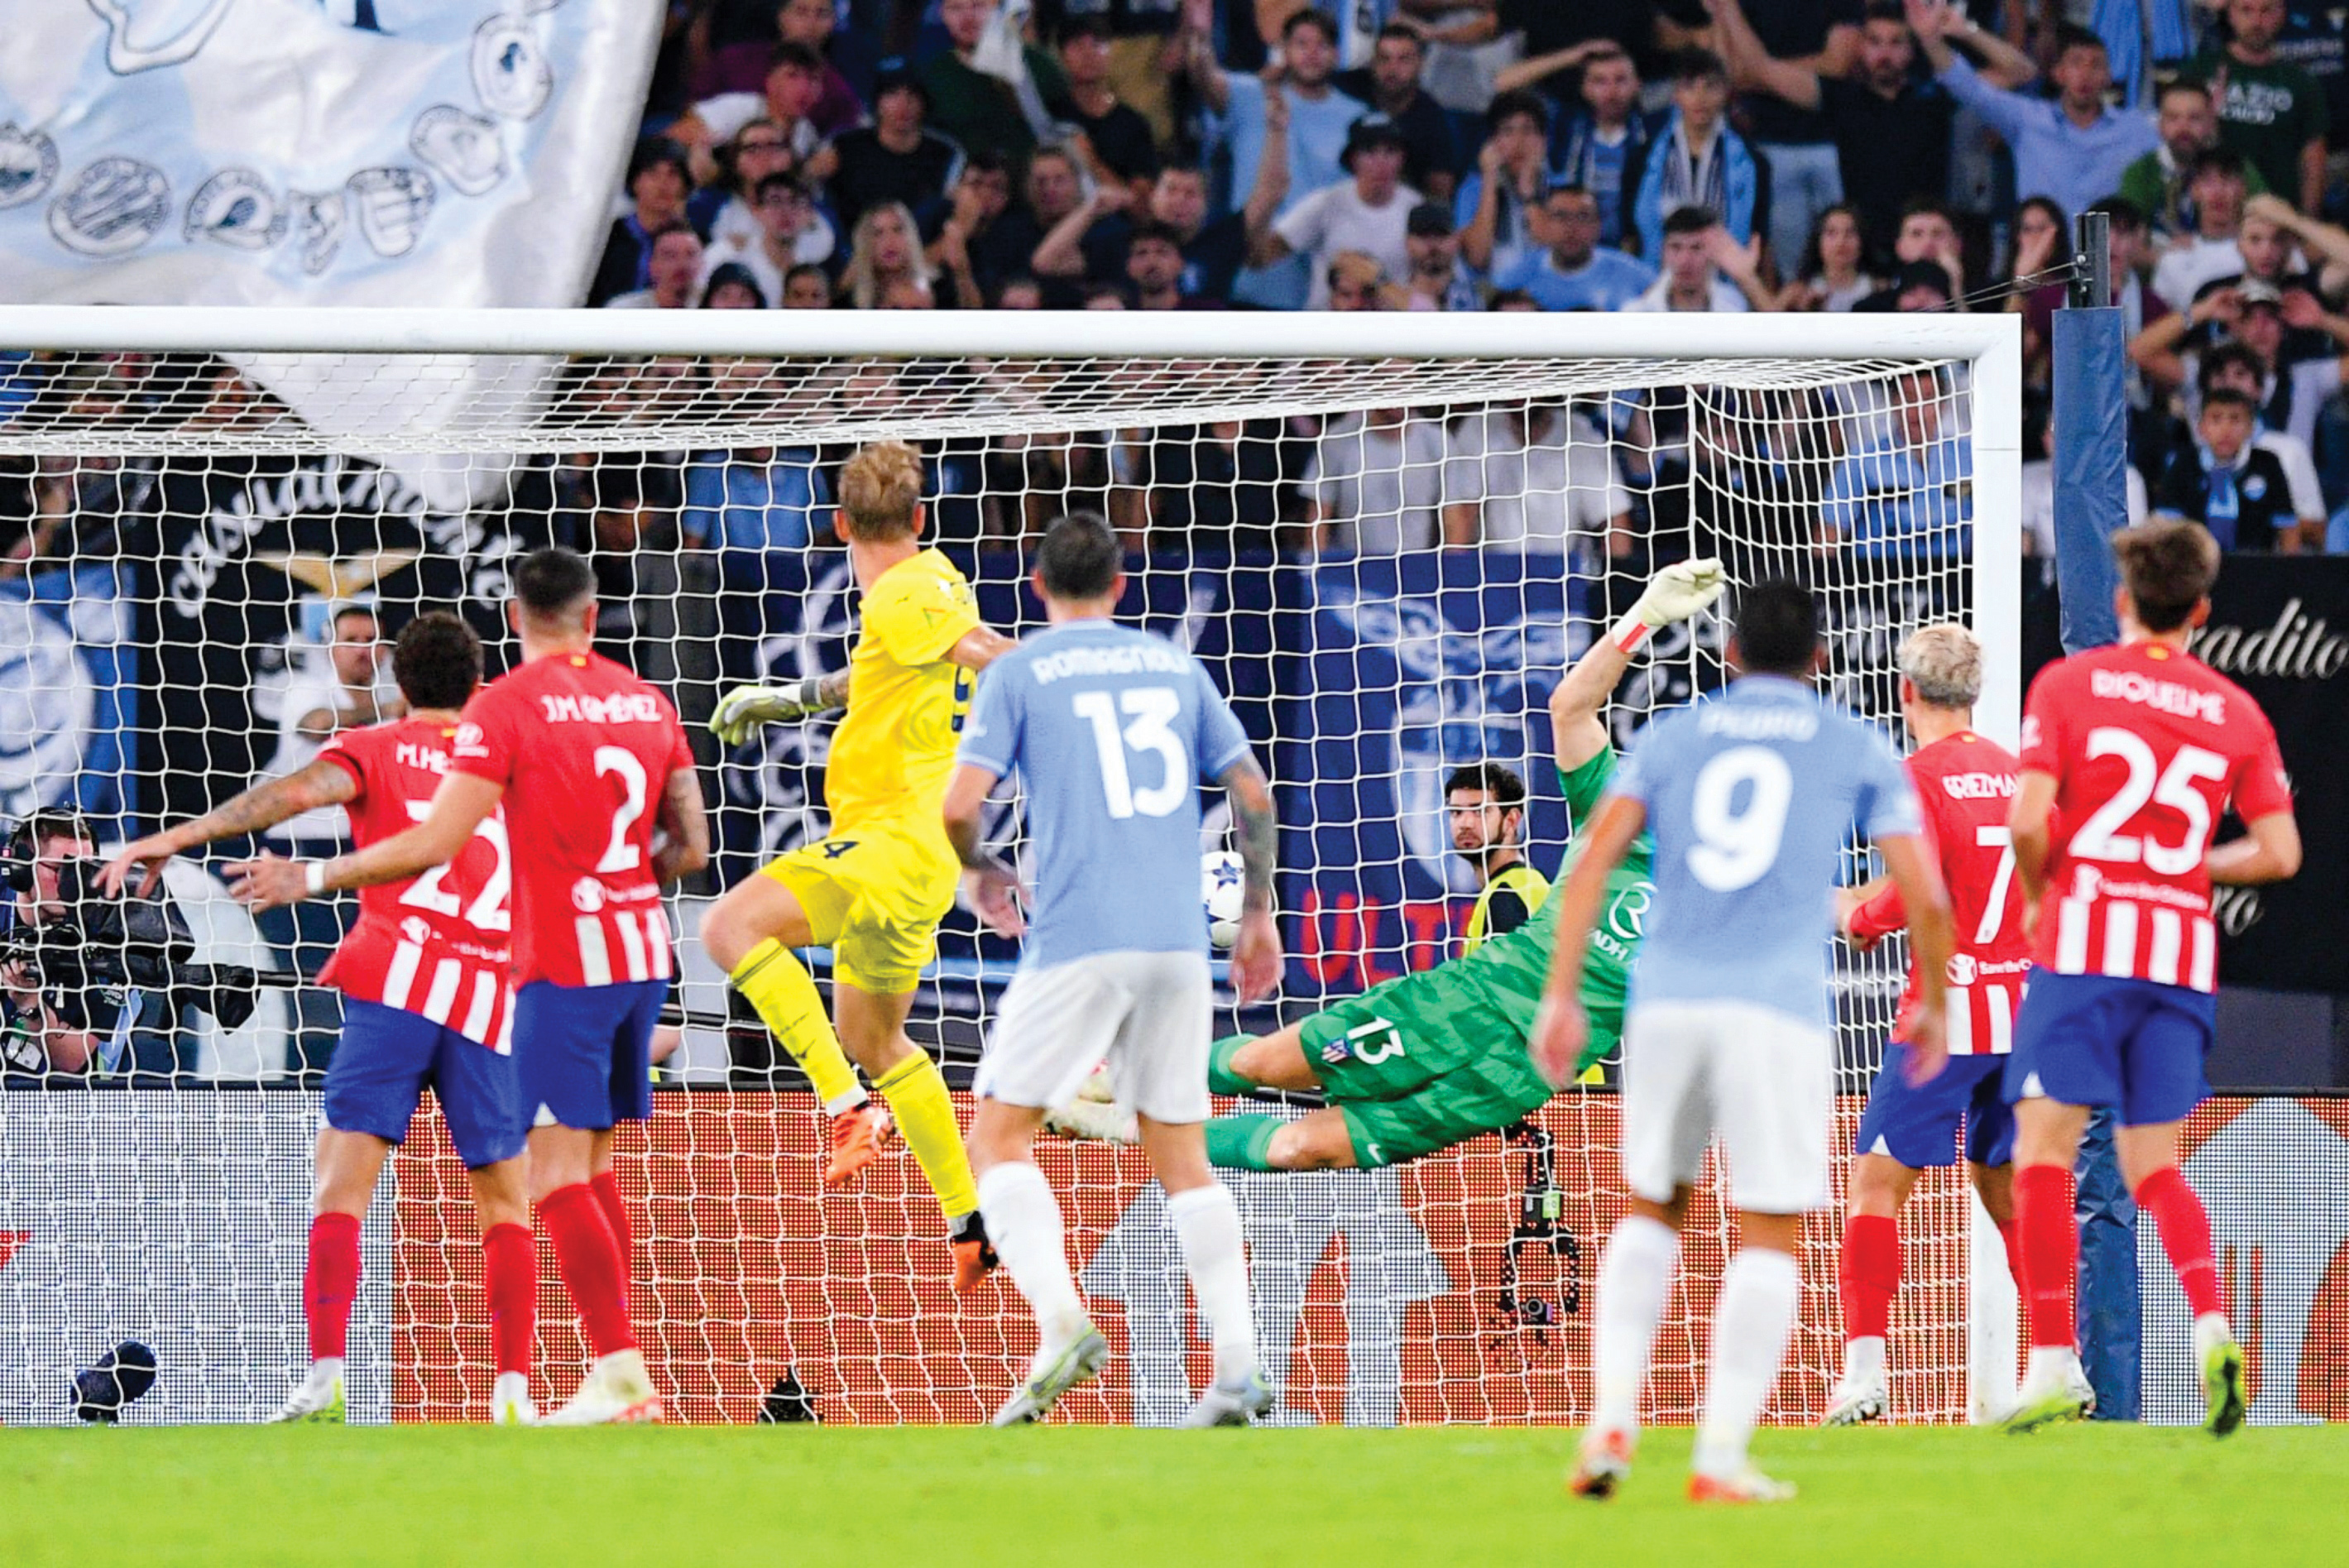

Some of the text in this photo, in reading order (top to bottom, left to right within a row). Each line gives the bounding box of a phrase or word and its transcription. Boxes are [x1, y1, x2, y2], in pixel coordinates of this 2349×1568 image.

[594, 745, 647, 874] 2
[1072, 686, 1188, 819] 13
[2069, 726, 2229, 875] 25
[819, 838, 860, 859] 4
[1685, 745, 1794, 893] 9
[1299, 889, 1475, 989] ULT
[1974, 826, 2016, 943] 7
[1347, 1016, 1405, 1066] 13
